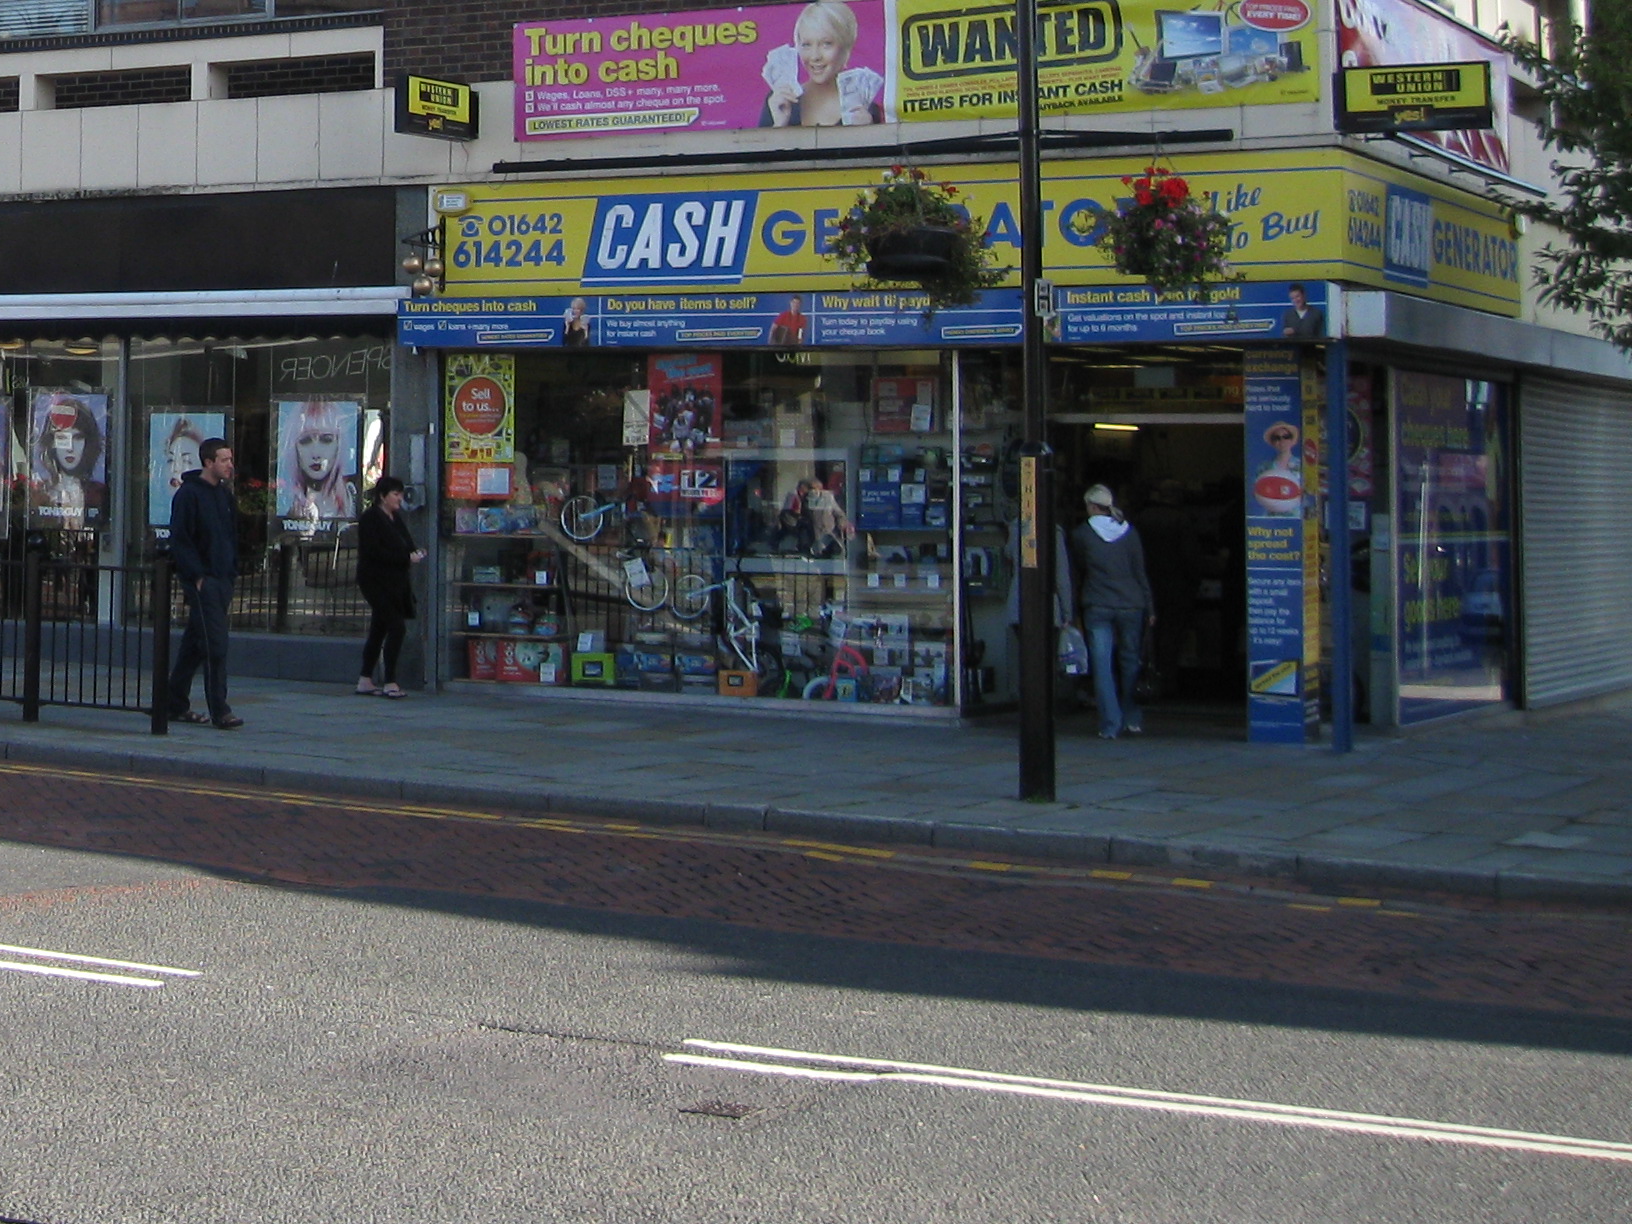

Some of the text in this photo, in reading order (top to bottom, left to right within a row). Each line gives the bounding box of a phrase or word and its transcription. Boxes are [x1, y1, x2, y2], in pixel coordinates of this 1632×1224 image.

[524, 20, 758, 56] Turn cheques
[524, 51, 679, 86] into cash
[1372, 71, 1443, 84] WESTERN
[606, 88, 627, 97] DSS
[666, 86, 692, 96] many
[1396, 81, 1443, 92] UNION
[560, 101, 582, 110] cash
[584, 99, 616, 109] almost
[617, 99, 635, 109] any
[636, 97, 670, 109] cheque
[672, 98, 685, 106] on
[686, 95, 701, 104] the
[903, 97, 954, 113] ITEMS
[959, 93, 993, 108] FOR
[1074, 79, 1123, 96] CASH
[1376, 95, 1456, 105] MONEY TRANSFER
[533, 113, 686, 130] LOWEST RATES GUARANTEED!
[488, 213, 563, 236] 01642
[1260, 210, 1320, 241] Buy
[597, 200, 746, 269] CASH
[1390, 195, 1518, 283] CASH GENERATOR
[453, 239, 566, 268] 614244
[822, 295, 880, 310] Why wait
[1067, 290, 1113, 304] Instant
[1117, 288, 1150, 302] cash
[1210, 287, 1240, 303] gold
[404, 299, 537, 314] Turn cheques into cash
[607, 296, 757, 313] Do you have items to sell?
[1107, 324, 1138, 332] months
[1245, 362, 1298, 375] exchange
[471, 388, 490, 400] Sell
[462, 401, 474, 412] to
[1248, 527, 1294, 538] Why not
[1248, 539, 1288, 550] spread
[1248, 551, 1300, 560] the cost?
